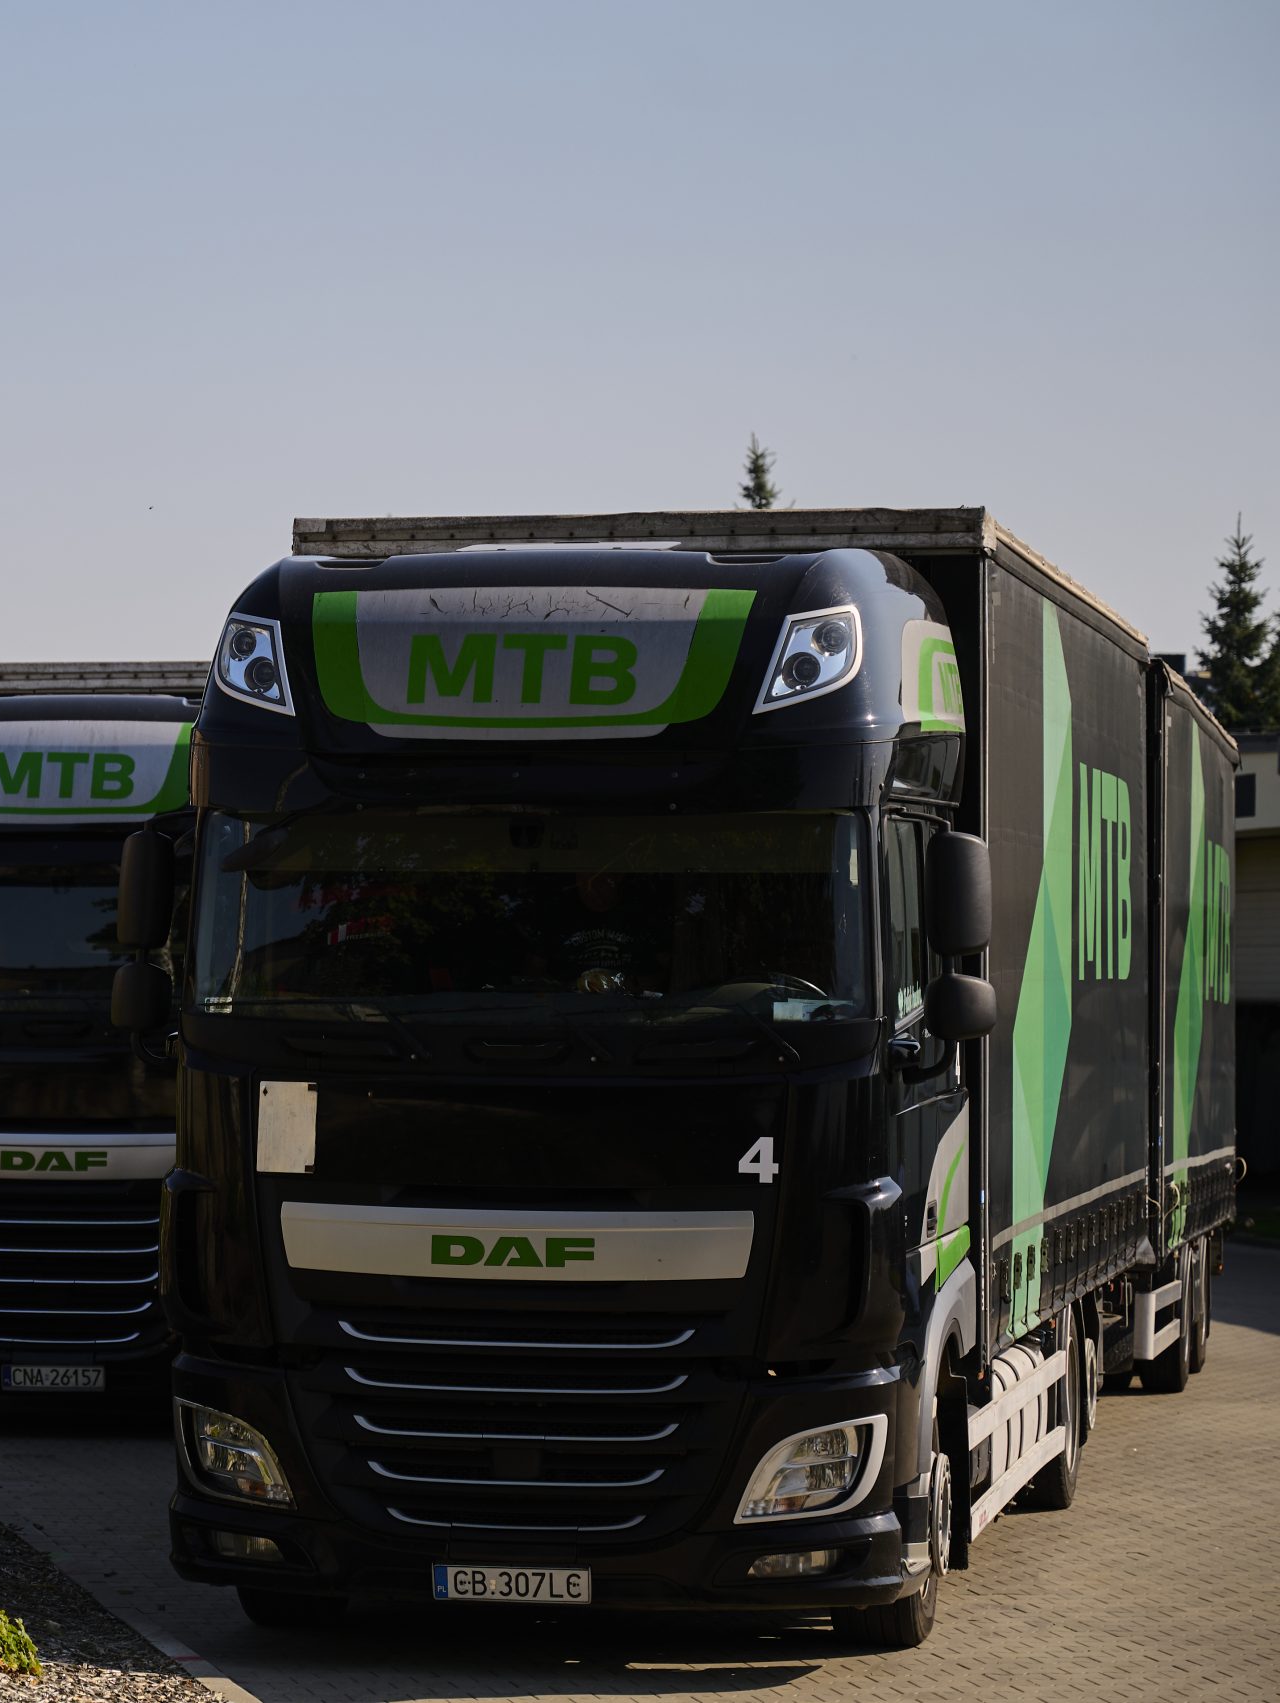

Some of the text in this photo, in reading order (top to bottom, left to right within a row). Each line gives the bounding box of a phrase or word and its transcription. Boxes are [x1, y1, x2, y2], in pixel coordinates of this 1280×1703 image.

[406, 633, 639, 705] MTB
[1079, 762, 1131, 981] MTB
[1205, 840, 1230, 1004] MTB
[0, 1150, 108, 1172] DAF
[738, 1137, 779, 1183] 4
[430, 1234, 595, 1268] DAF
[12, 1368, 101, 1386] CNA 26157
